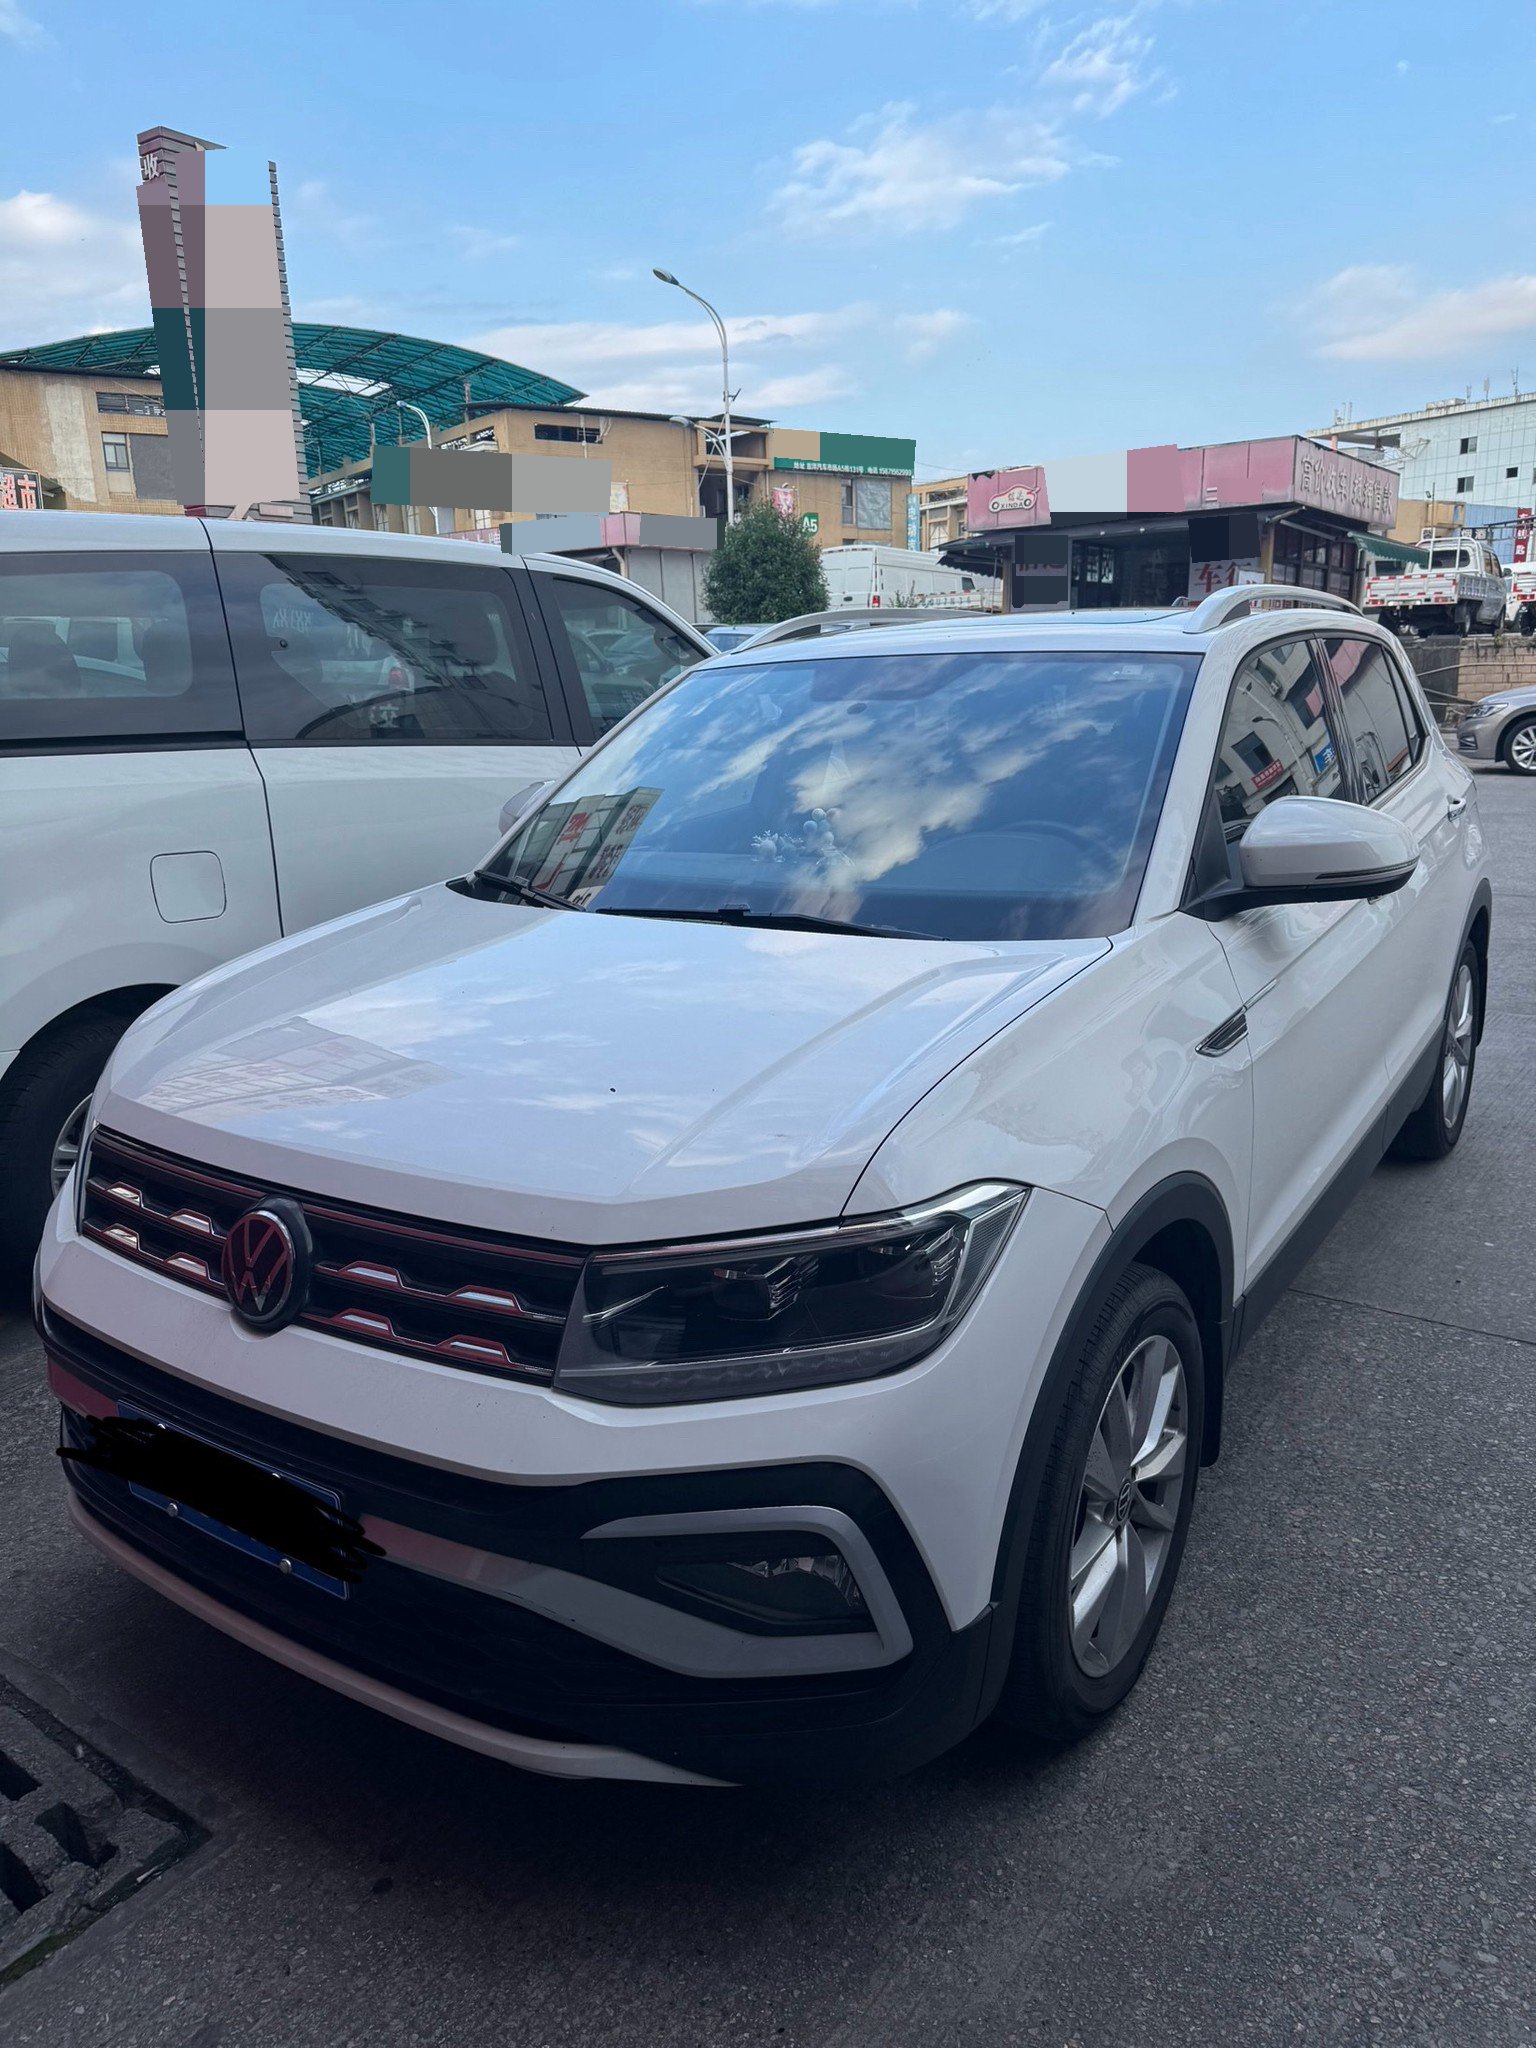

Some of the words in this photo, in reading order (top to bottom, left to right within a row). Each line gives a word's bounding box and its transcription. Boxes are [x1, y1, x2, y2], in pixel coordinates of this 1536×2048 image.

[1300, 455, 1349, 503] 高价收车
[1351, 474, 1393, 516] 抵押借款
[801, 516, 818, 533] A5
